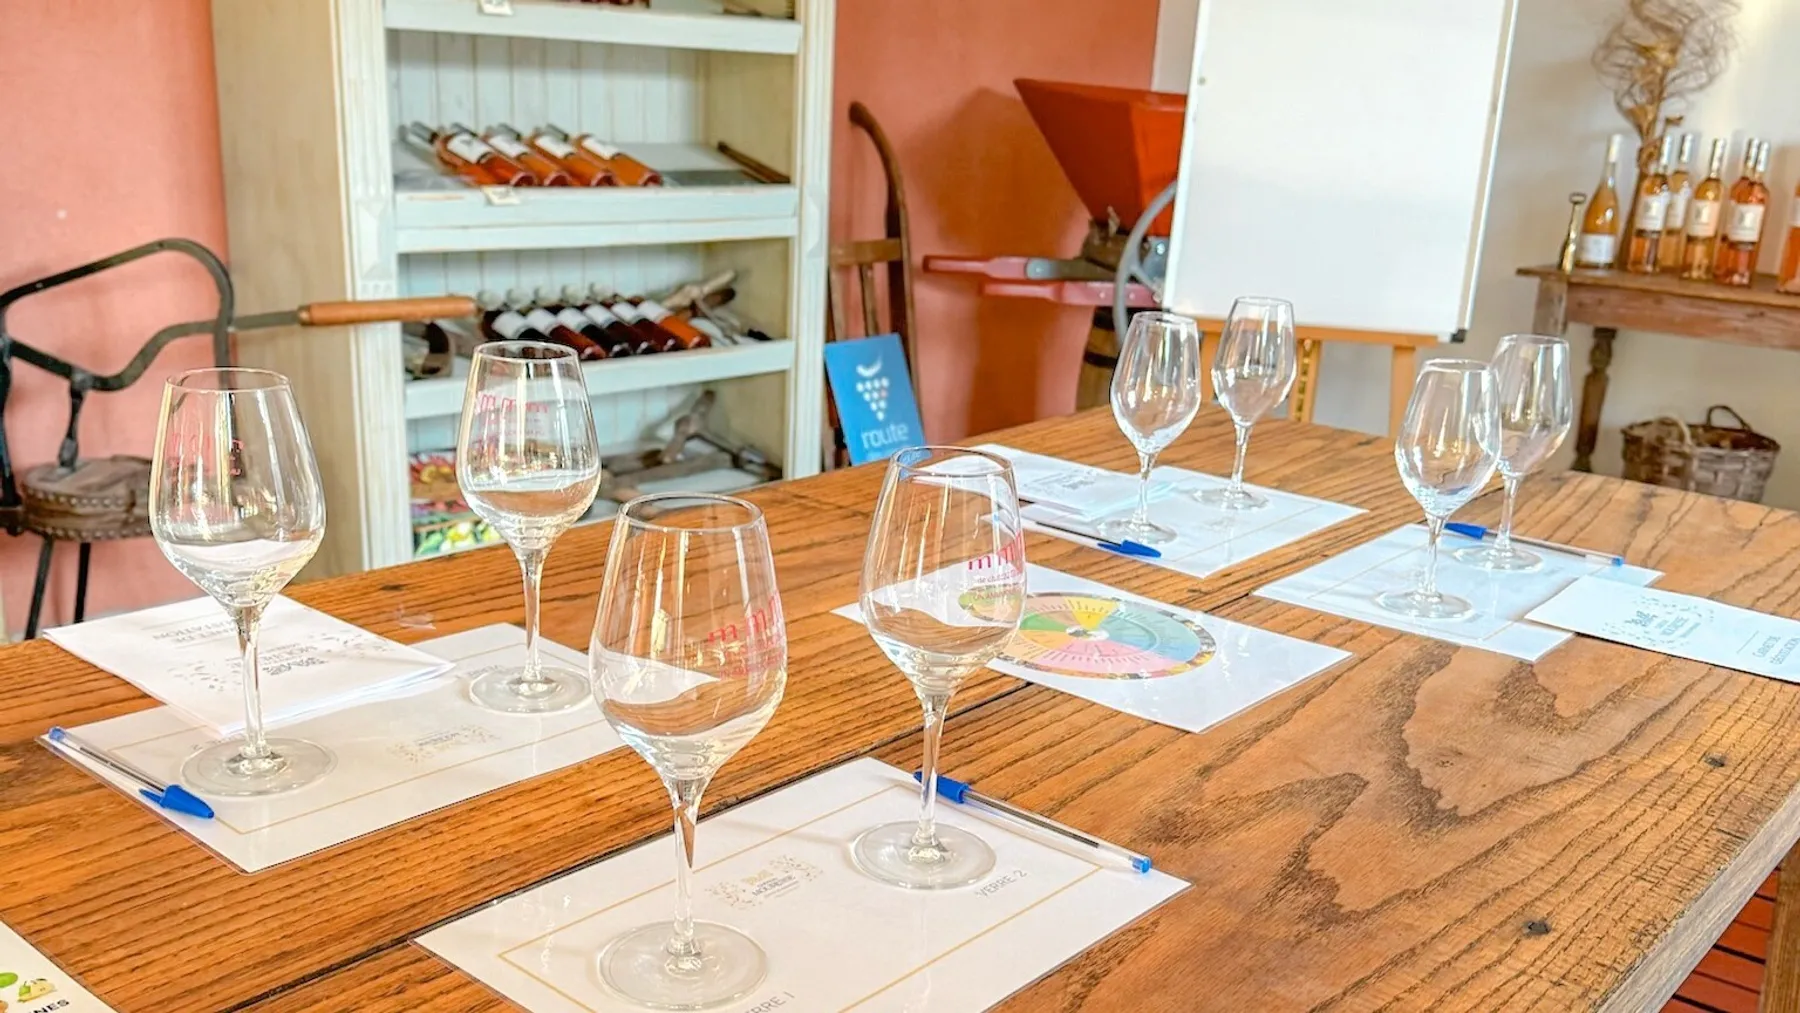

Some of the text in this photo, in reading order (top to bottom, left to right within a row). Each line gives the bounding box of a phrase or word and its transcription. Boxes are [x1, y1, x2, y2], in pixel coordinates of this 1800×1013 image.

[861, 423, 909, 449] route
[974, 869, 1028, 899] VERRE 2
[28, 999, 70, 1013] NES
[744, 995, 787, 1013] RRE
